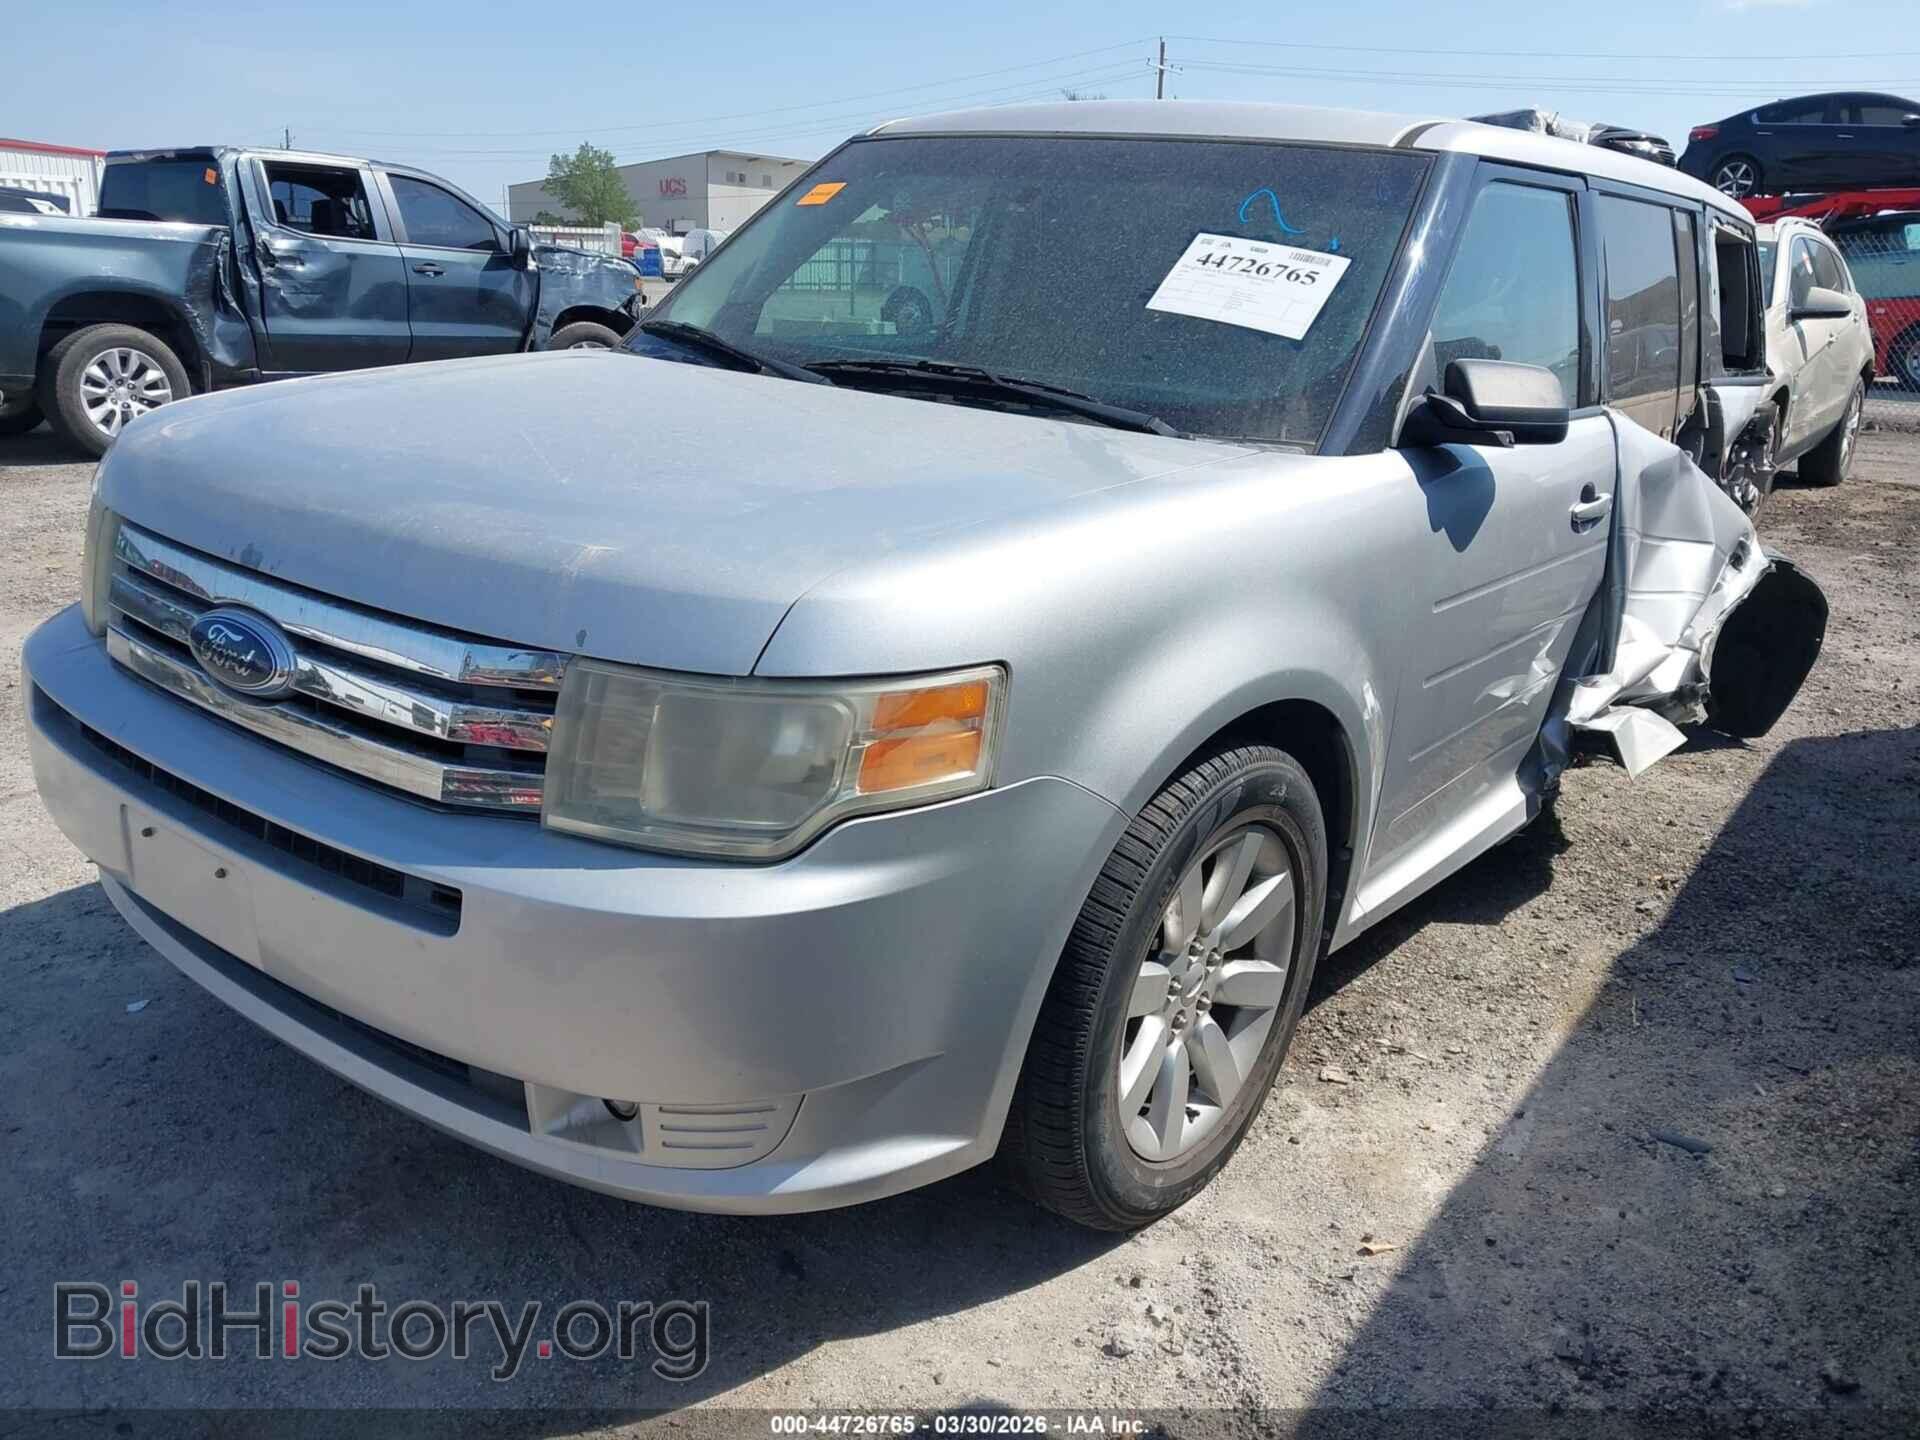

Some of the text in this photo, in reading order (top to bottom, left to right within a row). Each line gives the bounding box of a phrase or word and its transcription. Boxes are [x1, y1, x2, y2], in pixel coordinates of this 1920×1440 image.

[659, 177, 688, 194] UCS
[1196, 252, 1321, 286] 44726765
[200, 623, 256, 677] Ford
